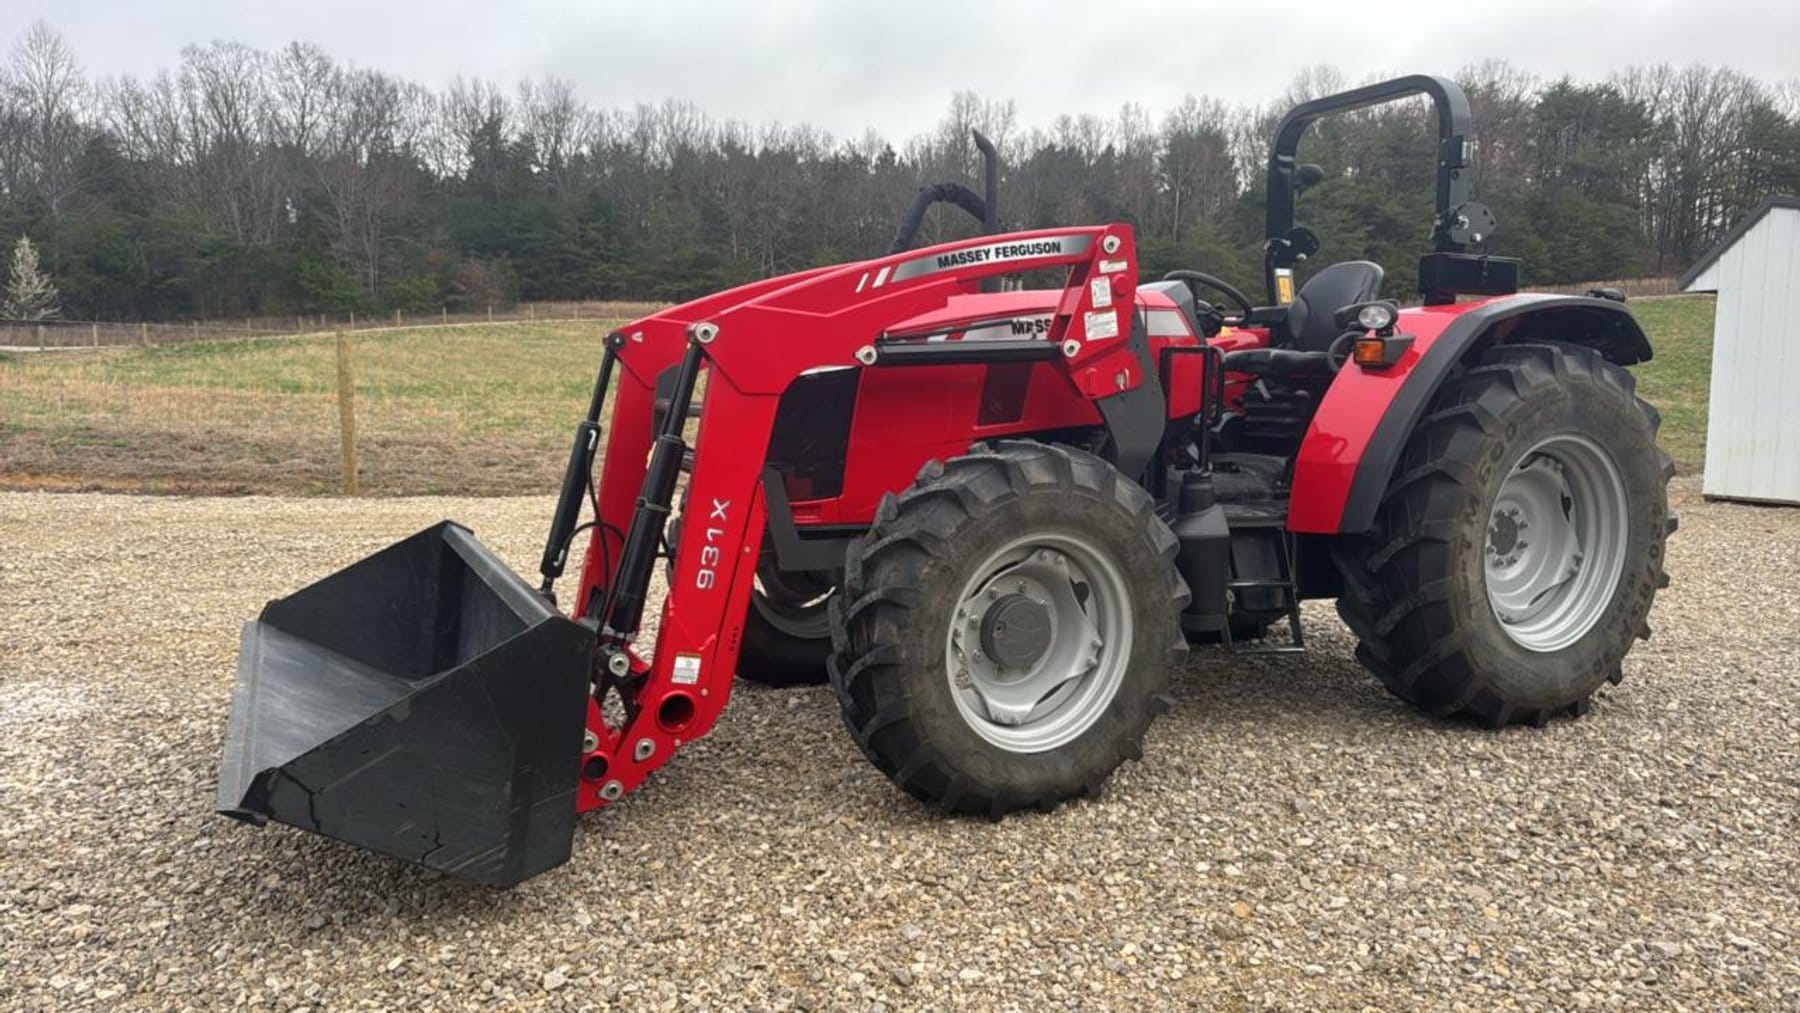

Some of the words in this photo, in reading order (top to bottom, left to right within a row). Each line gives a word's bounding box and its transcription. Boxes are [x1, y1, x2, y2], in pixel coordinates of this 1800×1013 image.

[937, 248, 991, 269] MASSEY
[994, 241, 1062, 259] FERGUSON
[696, 528, 724, 590] 931
[710, 498, 731, 521] X
